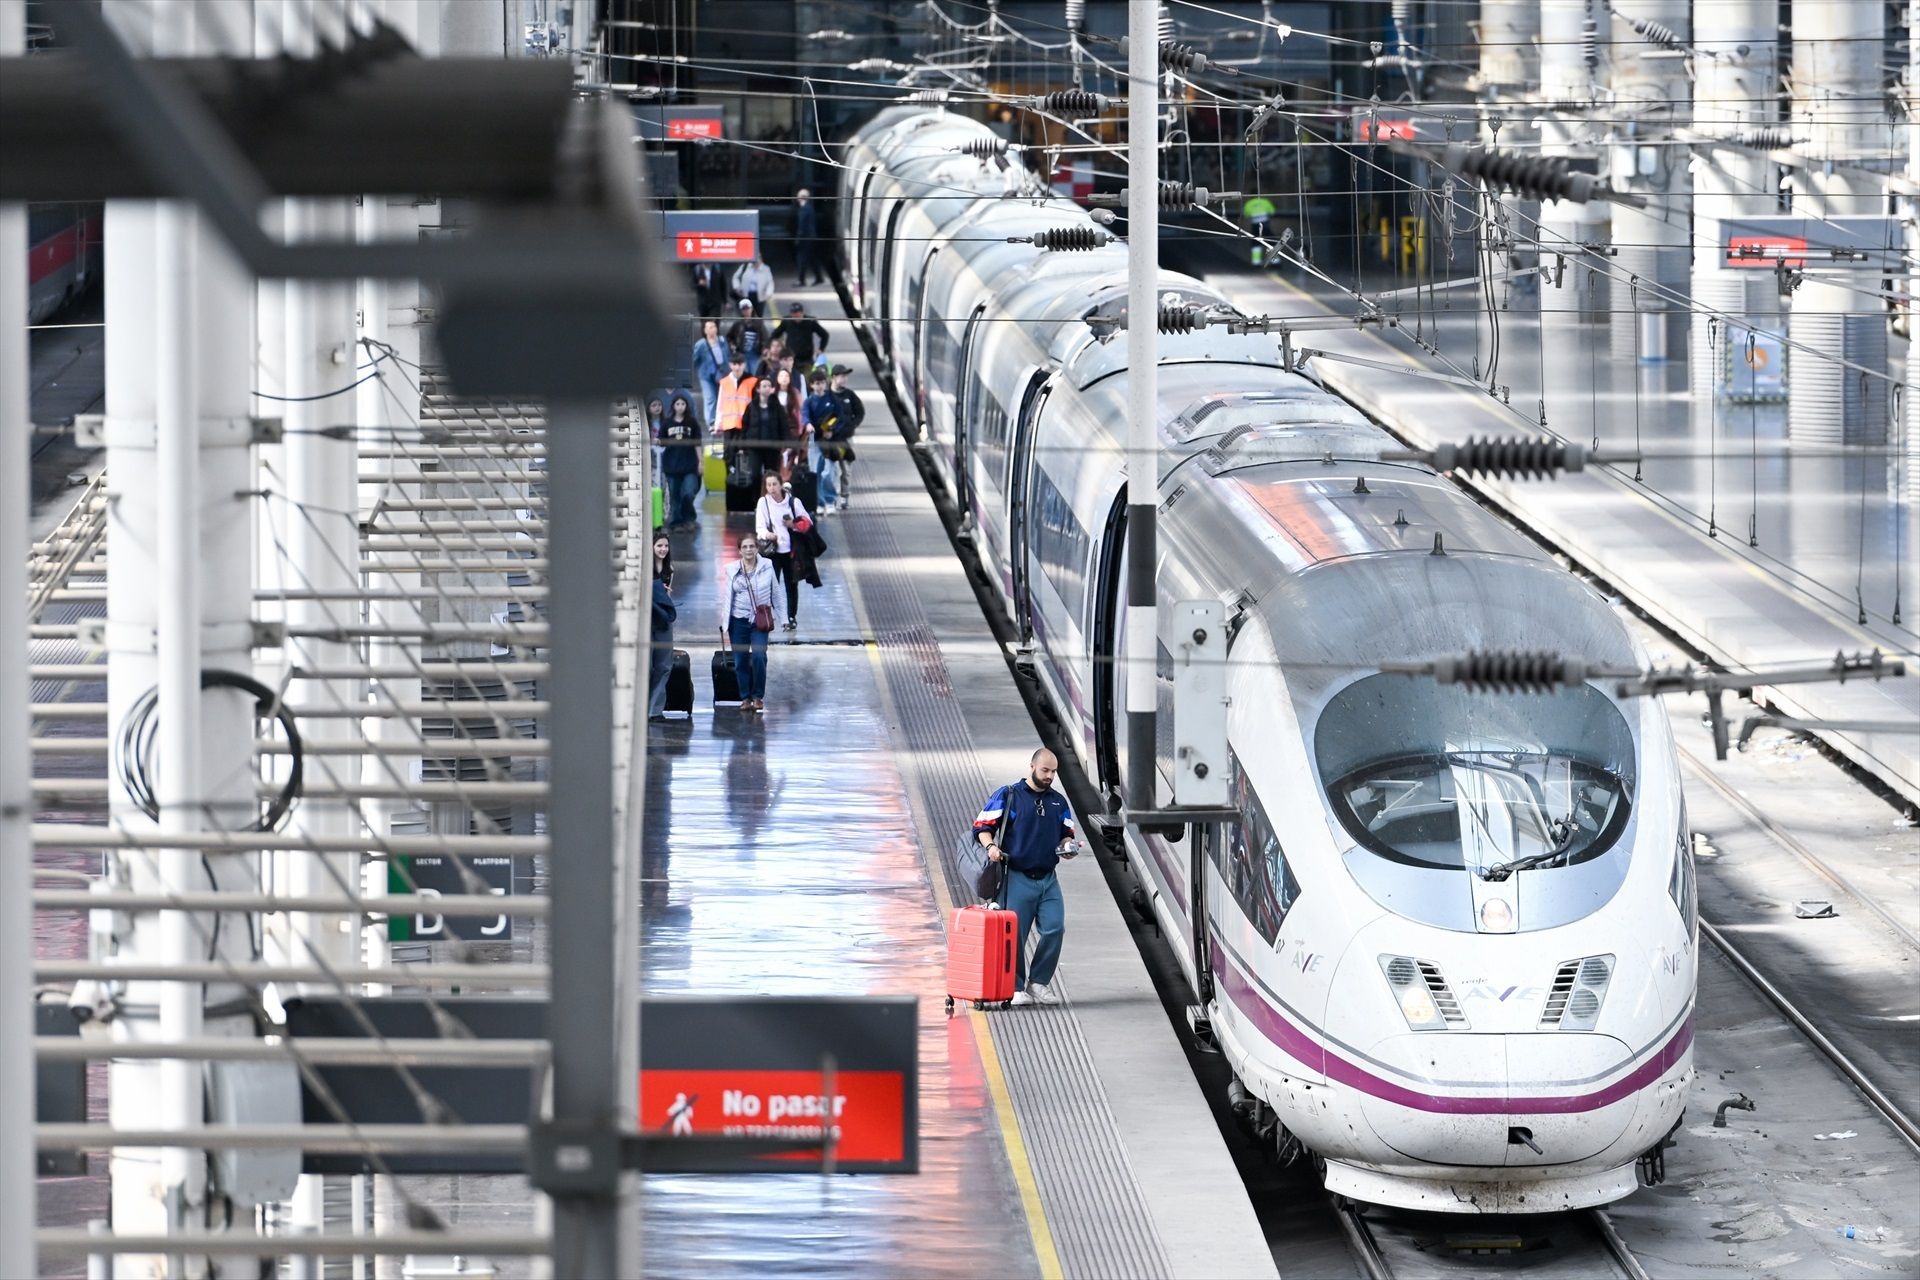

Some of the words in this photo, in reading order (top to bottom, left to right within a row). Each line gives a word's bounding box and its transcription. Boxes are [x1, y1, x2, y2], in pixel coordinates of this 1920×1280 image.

[1291, 950, 1325, 974] AVE
[1463, 985, 1546, 1002] AVE
[722, 1089, 760, 1117] No
[768, 1094, 847, 1121] pasar
